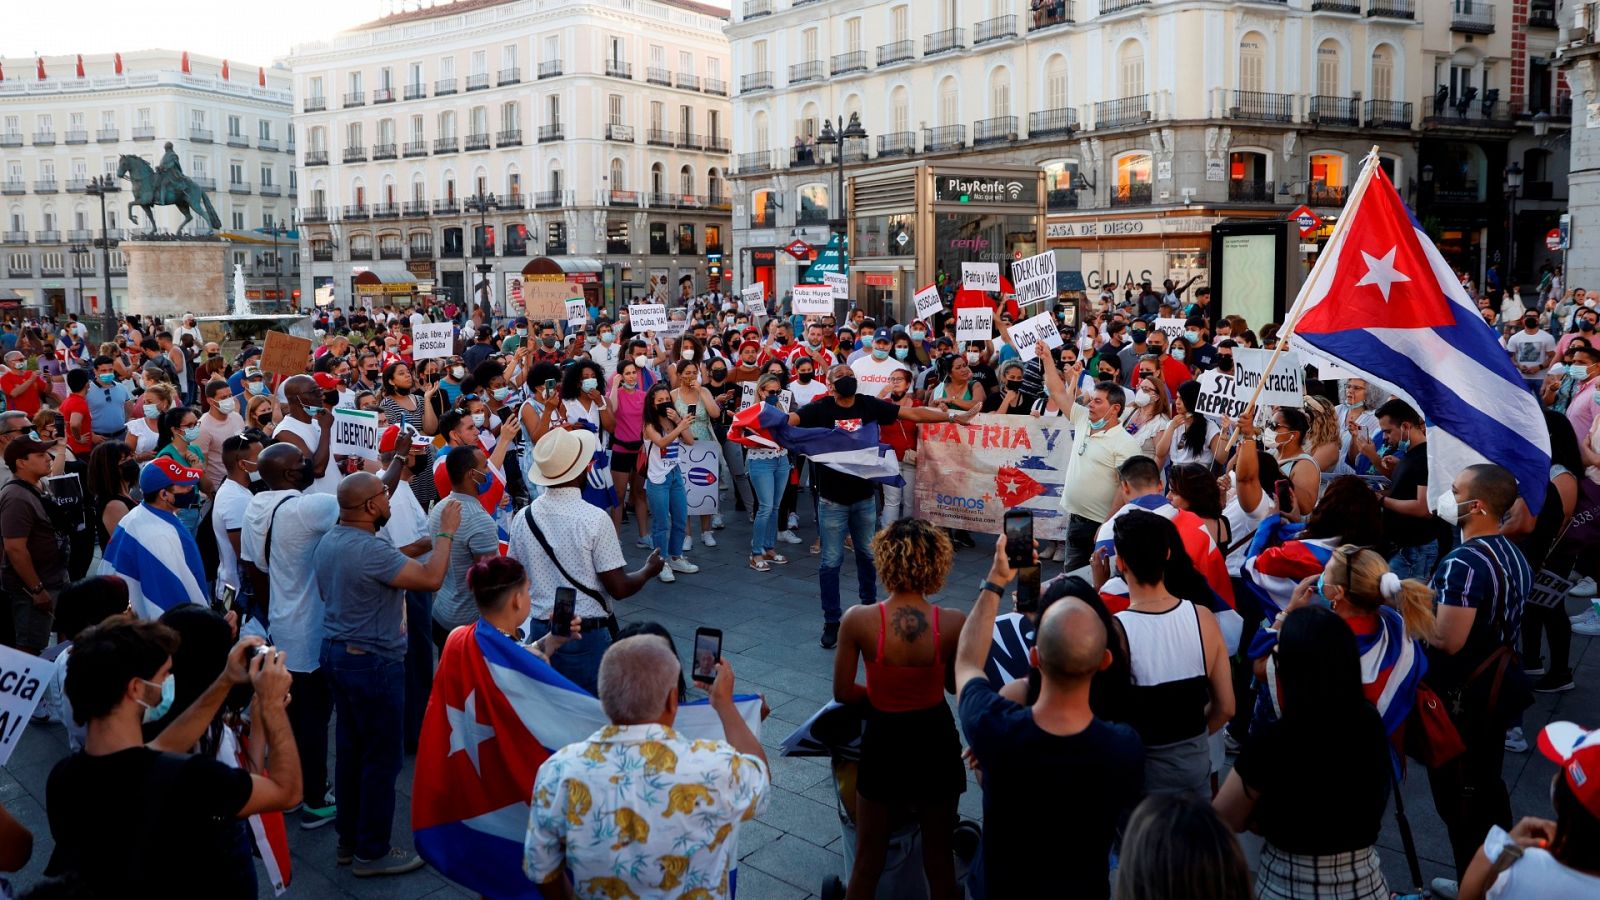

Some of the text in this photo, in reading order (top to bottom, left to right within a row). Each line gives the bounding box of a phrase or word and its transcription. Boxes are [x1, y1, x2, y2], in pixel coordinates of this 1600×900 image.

[949, 179, 1004, 195] PlayRenfe
[1081, 222, 1096, 235] DE
[1104, 220, 1144, 234] DIEGO
[950, 234, 989, 251] renfe
[754, 251, 774, 260] Orange
[1013, 254, 1054, 285] ¡DERECHOS
[981, 275, 985, 286] y
[812, 290, 830, 298] Huyes
[1016, 275, 1054, 305] HUMANOS!
[630, 305, 664, 315] Democracia
[656, 317, 667, 325] YA!
[975, 315, 991, 330] libre!
[1035, 319, 1058, 340] libre!
[419, 341, 445, 350] #SOSCuba
[1236, 362, 1298, 393] Democracia!
[336, 421, 377, 450] LIBERTAD!
[922, 422, 1032, 449] PATRIA
[1041, 426, 1061, 451] Y
